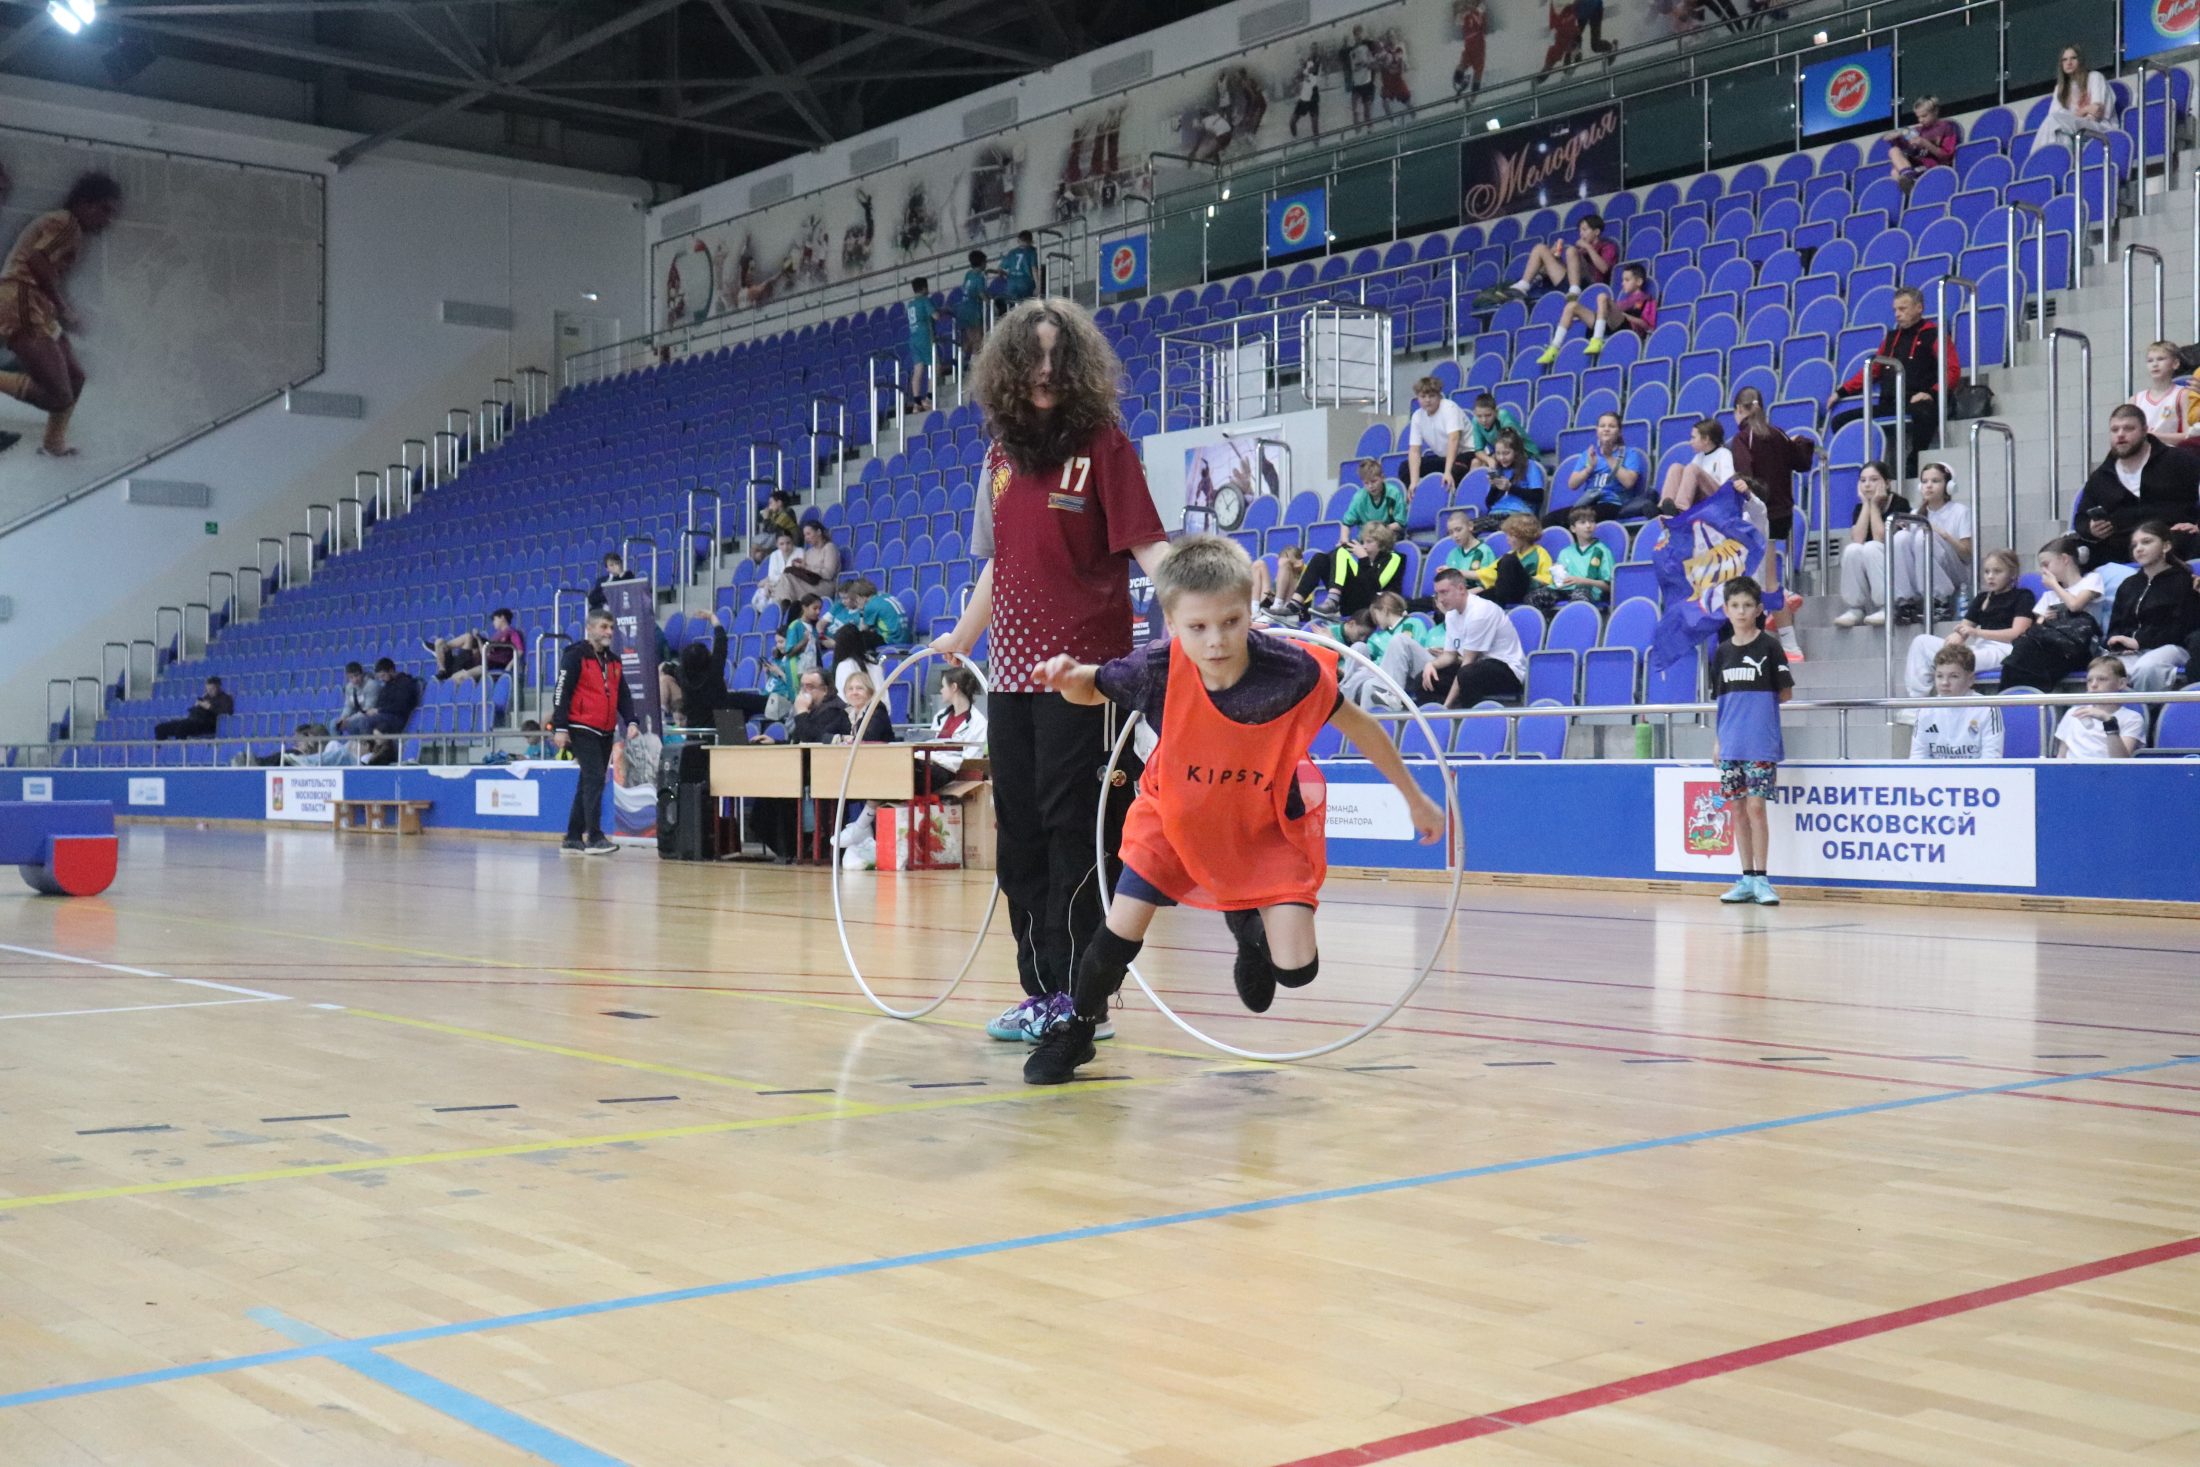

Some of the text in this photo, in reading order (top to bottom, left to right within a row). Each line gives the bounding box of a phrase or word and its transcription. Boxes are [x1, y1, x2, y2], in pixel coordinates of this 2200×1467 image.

[1465, 111, 1617, 220] Мелодия
[1015, 253, 1024, 271] 7
[1059, 456, 1091, 492] 17
[1129, 577, 1153, 589] УСПЕ
[1722, 667, 1756, 683] PUMA
[290, 778, 336, 788] ПРАВИТЕЛЬСТВО
[295, 790, 332, 801] МОСКОВСКОЙ
[1775, 786, 2001, 808] ПРАВИТЕЛЬСТВО
[1326, 804, 1359, 813] ОМАНДА
[1326, 816, 1373, 826] УБЕРНАТОРА
[1795, 811, 1976, 836] МОСКОВСКОЙ
[1822, 840, 1946, 863] ОБЛАСТИ
